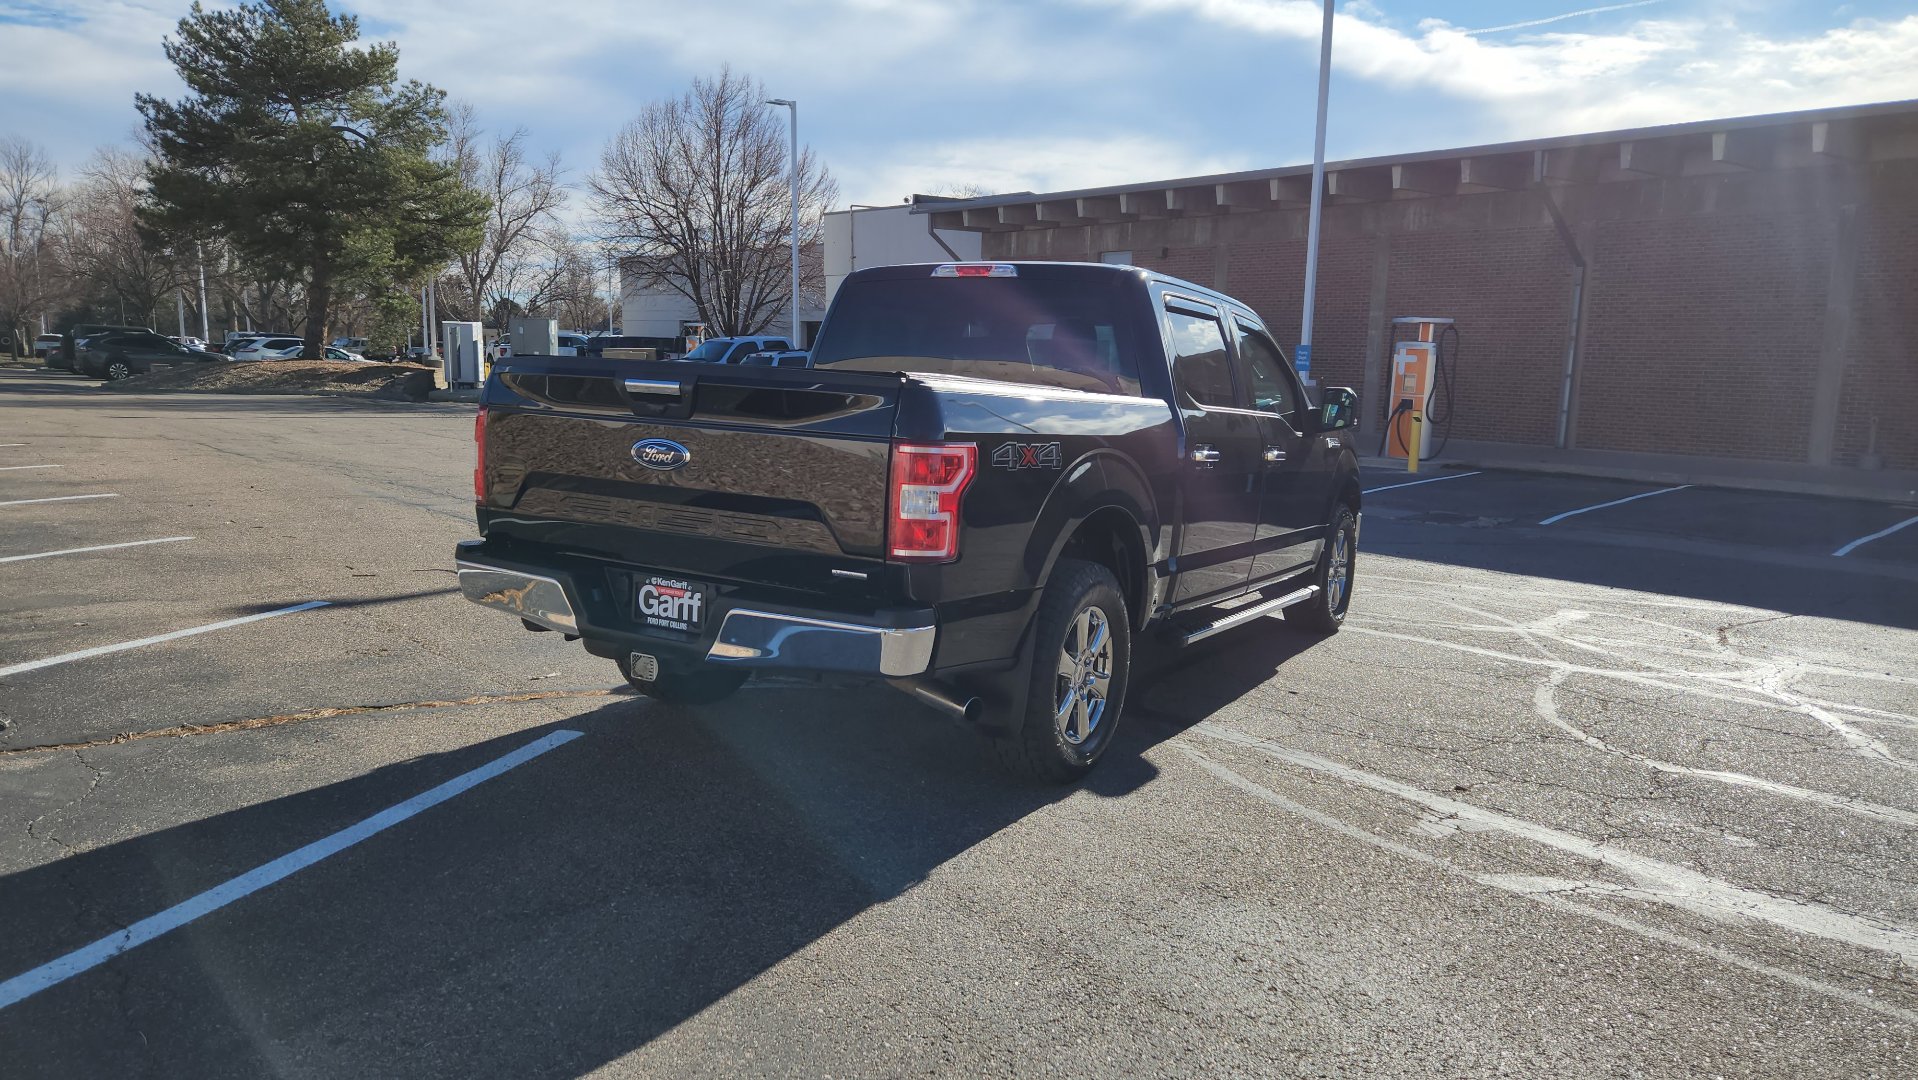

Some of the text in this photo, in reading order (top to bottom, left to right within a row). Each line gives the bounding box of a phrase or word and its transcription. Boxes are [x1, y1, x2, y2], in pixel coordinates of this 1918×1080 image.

[642, 444, 675, 463] Ford
[657, 578, 687, 589] Ken Garff
[639, 585, 701, 622] Garff
[647, 617, 687, 630] FORD FORT COLLINS
